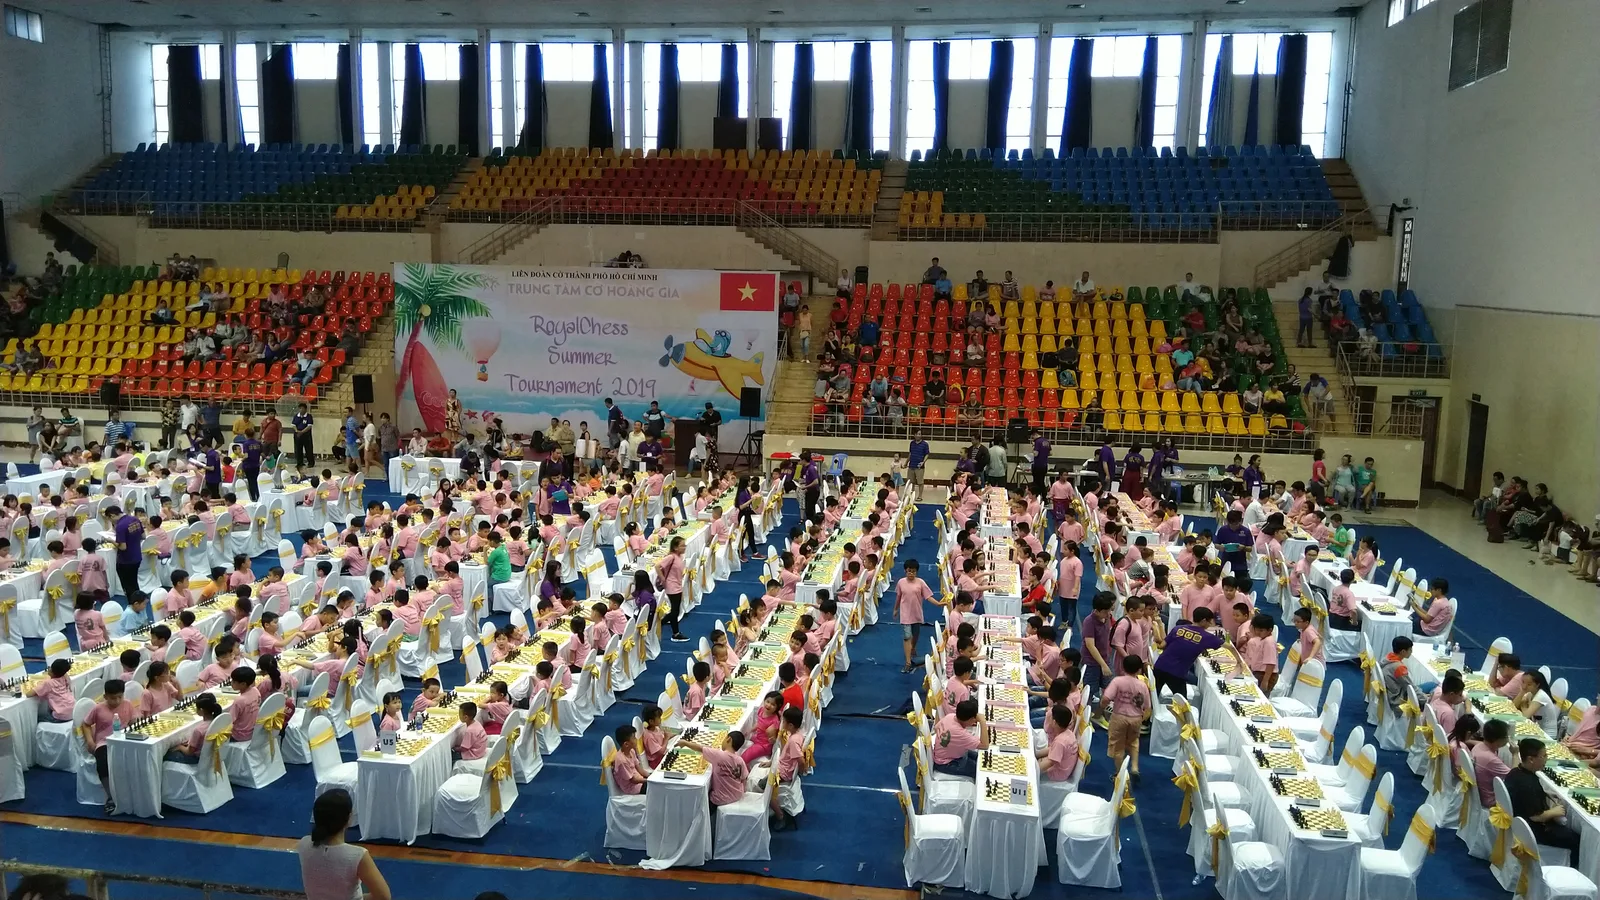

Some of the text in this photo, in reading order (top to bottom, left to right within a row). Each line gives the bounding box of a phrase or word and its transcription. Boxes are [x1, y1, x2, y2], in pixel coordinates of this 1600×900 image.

[508, 283, 550, 295] TRUNG
[554, 283, 581, 296] TÂM
[607, 285, 654, 298] HOÀNG
[658, 286, 680, 298] GIA
[530, 315, 629, 346] RoyalChess
[548, 346, 618, 366] Summer
[504, 374, 656, 398] Tournament 2019
